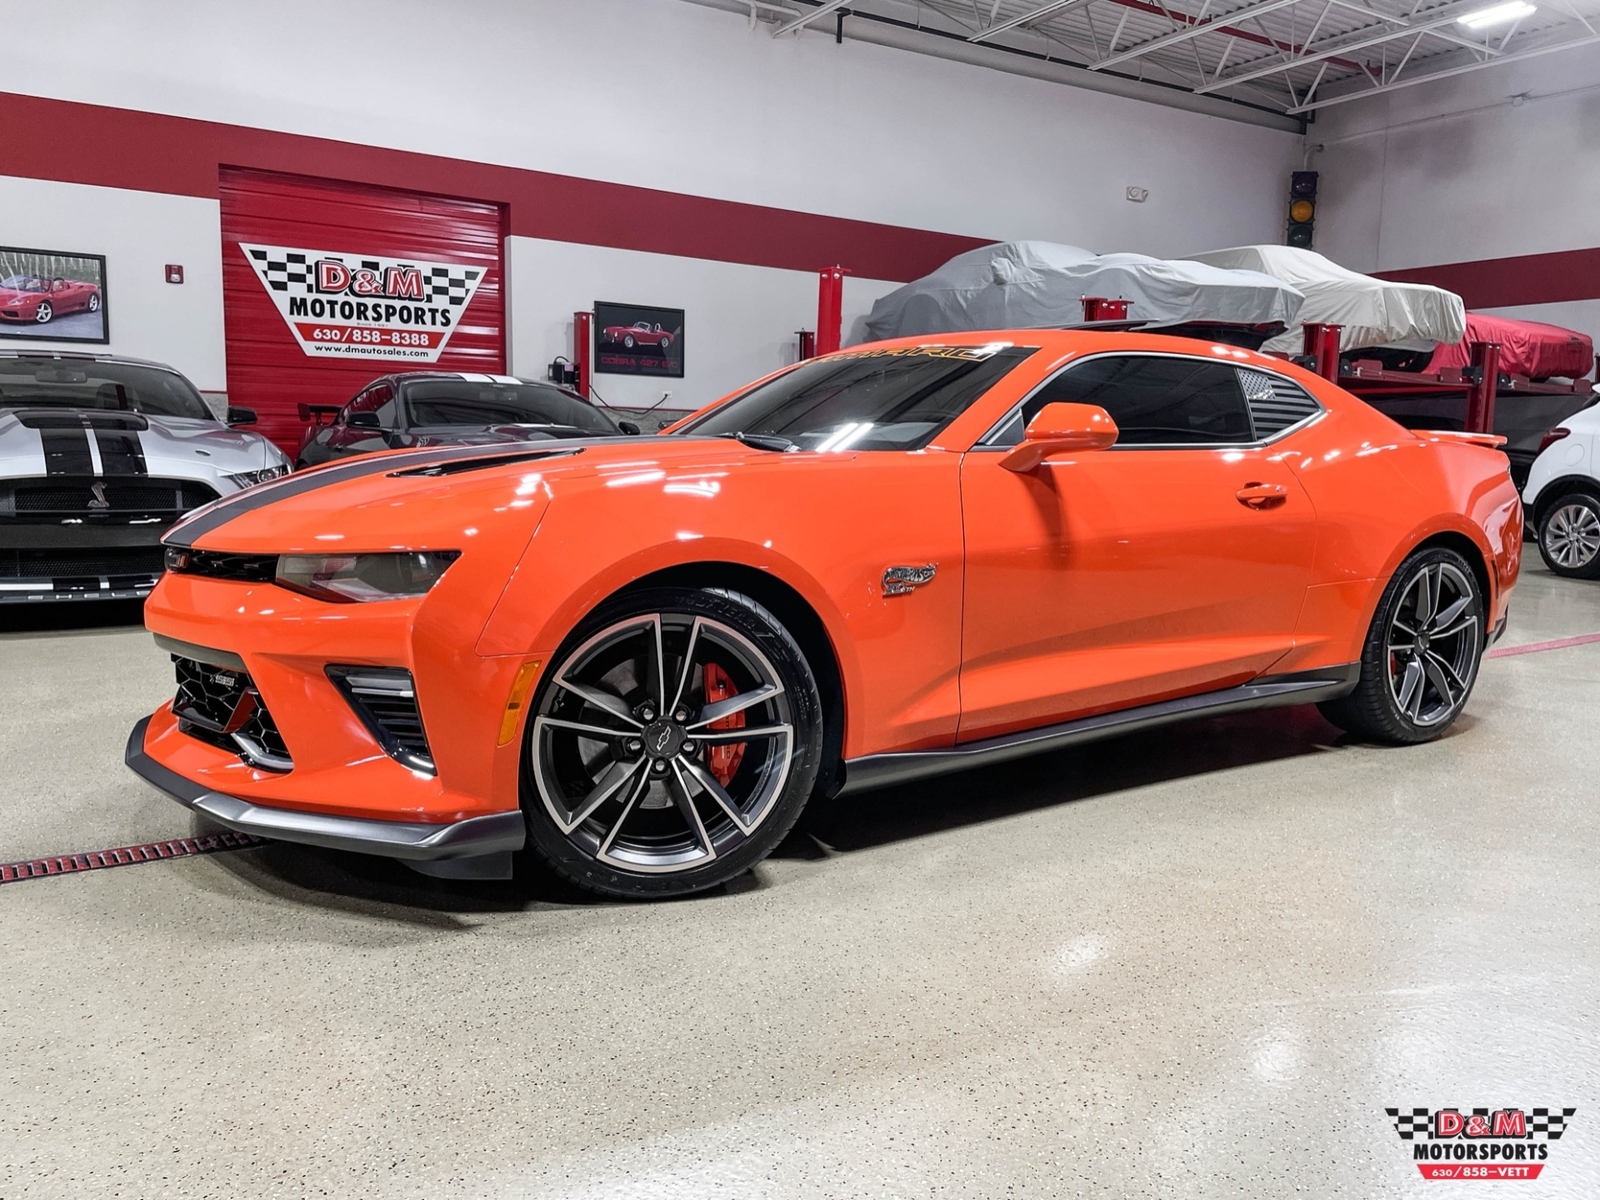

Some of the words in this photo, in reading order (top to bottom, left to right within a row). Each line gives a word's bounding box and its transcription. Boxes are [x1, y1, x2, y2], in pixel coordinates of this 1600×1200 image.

[315, 259, 426, 302] D&M
[289, 296, 452, 327] MOTORSPORTS
[313, 327, 430, 346] 630/858-8388
[314, 344, 429, 358] www.dmautosales.com
[601, 356, 636, 366] COBRA
[640, 359, 659, 367] 427
